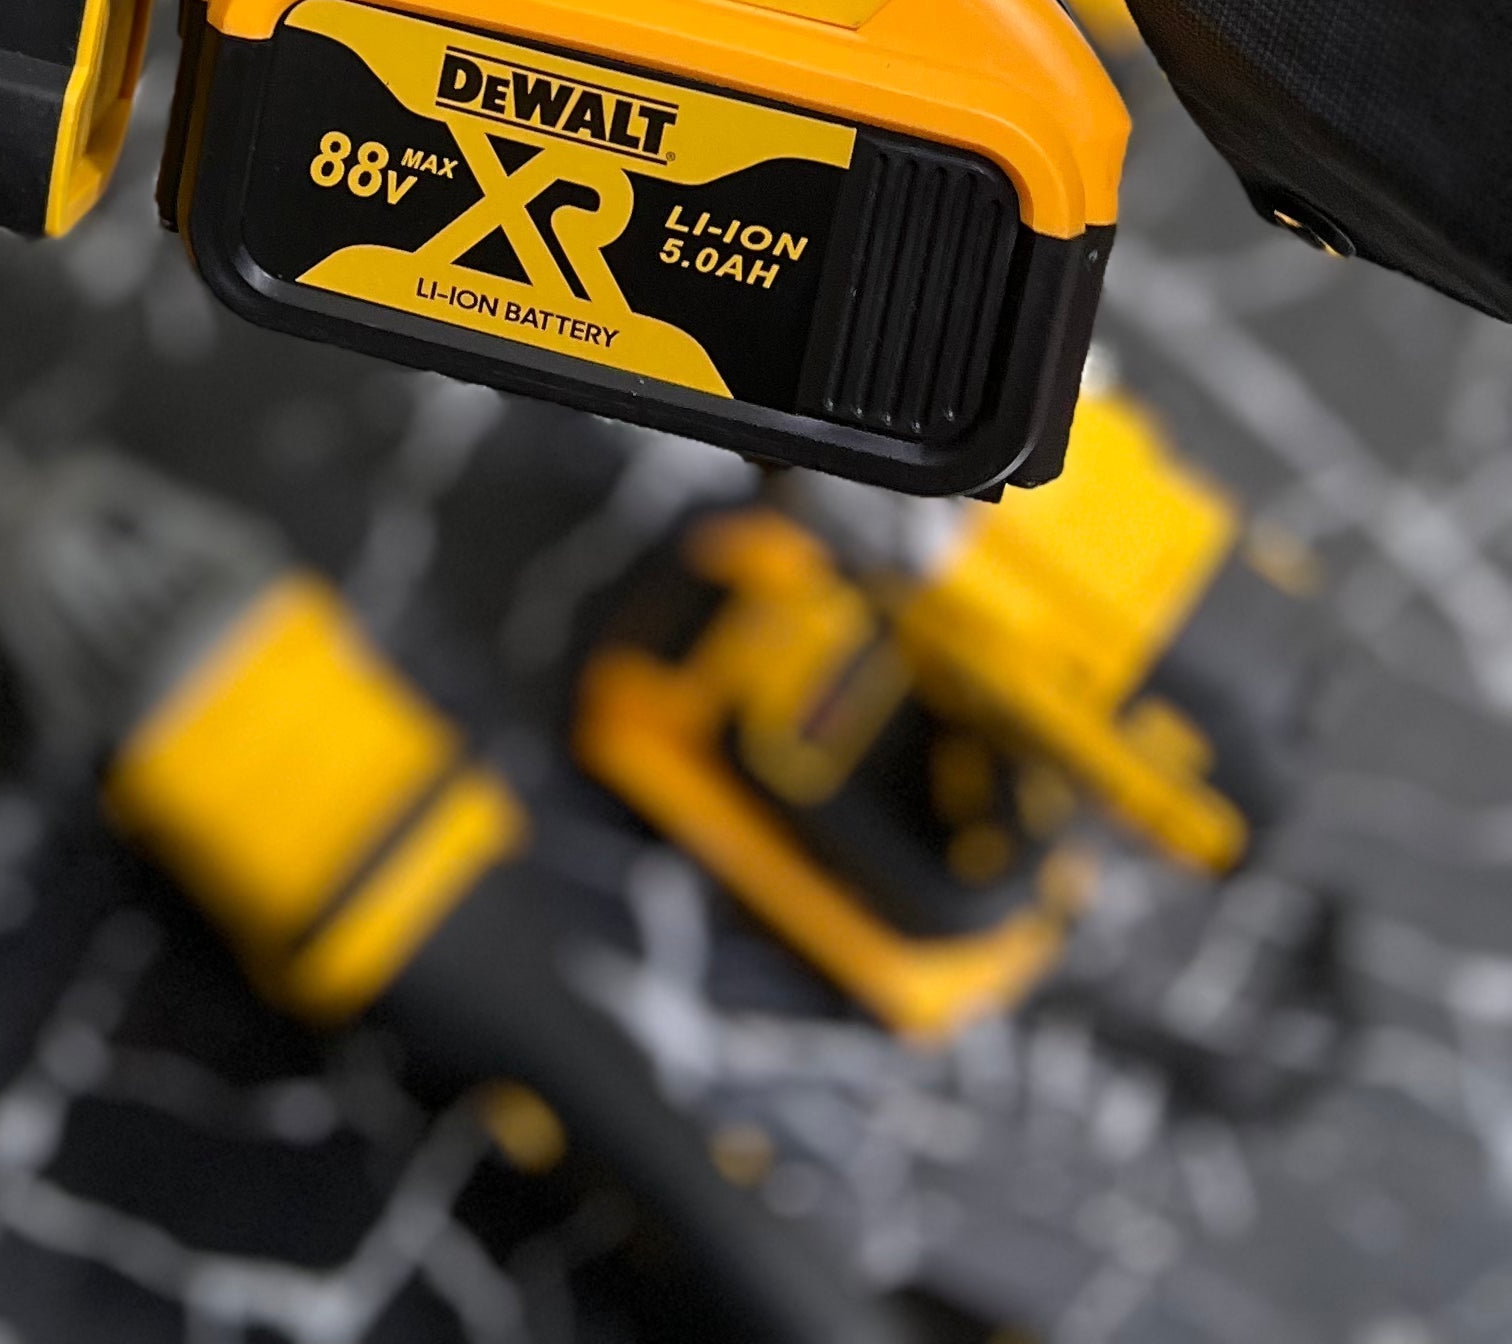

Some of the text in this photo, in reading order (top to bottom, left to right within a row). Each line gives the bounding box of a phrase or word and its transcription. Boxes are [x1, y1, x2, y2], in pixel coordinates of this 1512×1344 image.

[309, 130, 459, 205] 88V MAX
[413, 122, 635, 310] XR
[664, 204, 809, 262] LI-ION
[659, 237, 781, 290] 5.0AH
[415, 276, 620, 348] LI-ION BATTERY
